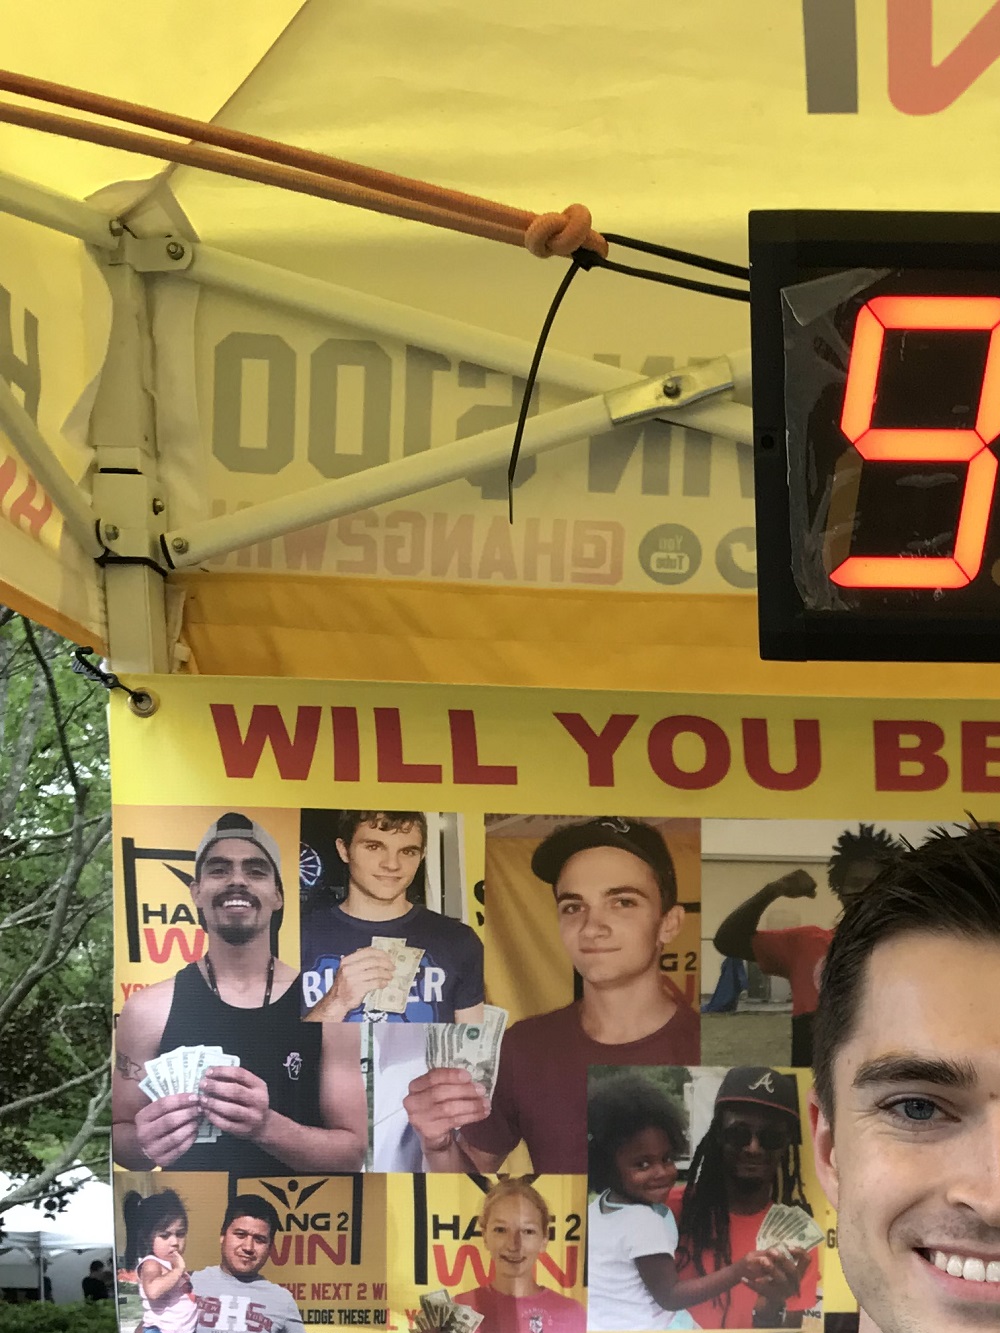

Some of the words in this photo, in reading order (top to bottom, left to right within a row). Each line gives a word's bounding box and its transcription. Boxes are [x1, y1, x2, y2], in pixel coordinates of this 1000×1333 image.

[210, 703, 518, 786] WILL
[552, 711, 822, 791] YOU
[311, 1283, 353, 1301] NEXT
[356, 1283, 367, 1301] 2
[337, 1309, 371, 1325] THESE
